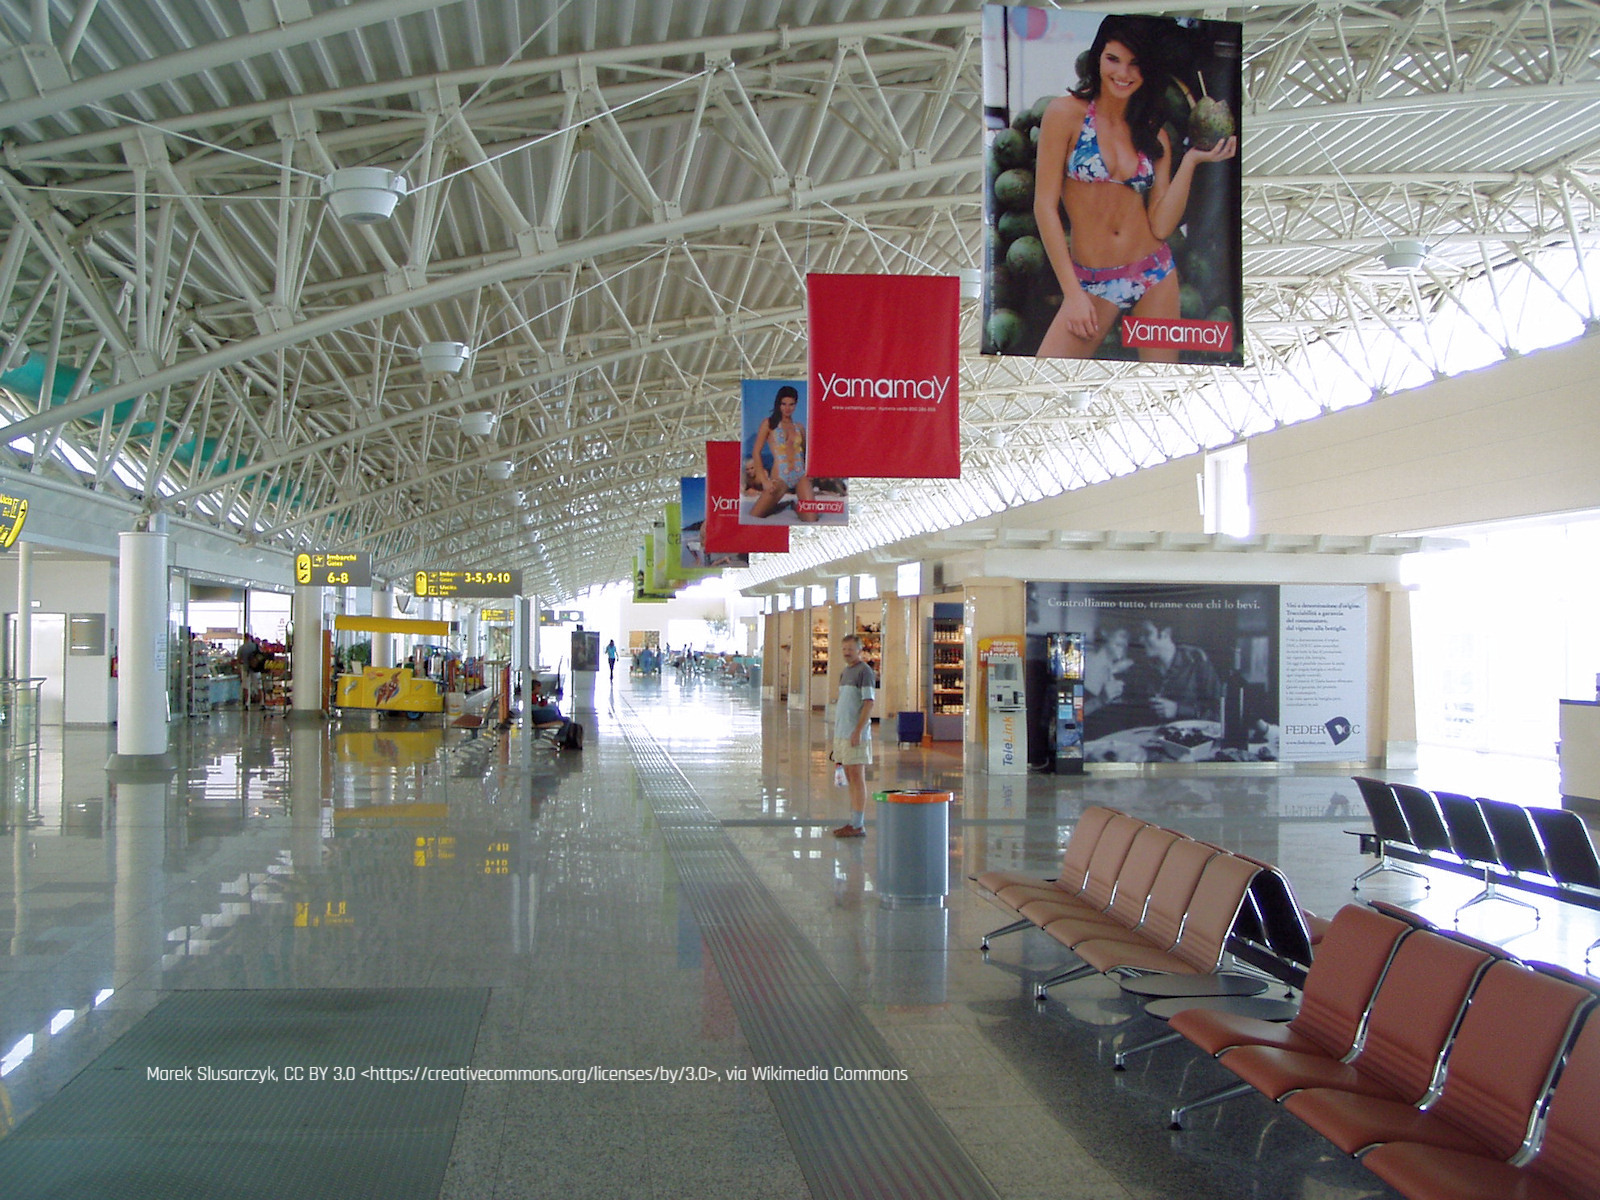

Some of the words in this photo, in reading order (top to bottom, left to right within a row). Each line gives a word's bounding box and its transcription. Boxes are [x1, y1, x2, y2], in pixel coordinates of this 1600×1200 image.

[1124, 319, 1229, 348] yamamay
[818, 372, 951, 404] yamamay
[798, 501, 843, 512] yamamay
[327, 571, 349, 584] 6-8
[464, 572, 511, 584] 3-5,9-10
[1047, 597, 1116, 607] Controlliamo
[1119, 600, 1147, 609] tutto,
[1150, 600, 1183, 609] tranne
[1185, 601, 1204, 609] con
[1206, 600, 1221, 609] chi
[1225, 600, 1234, 609] lo
[1236, 600, 1260, 609] bevi.
[1003, 716, 1014, 766] TeleLink
